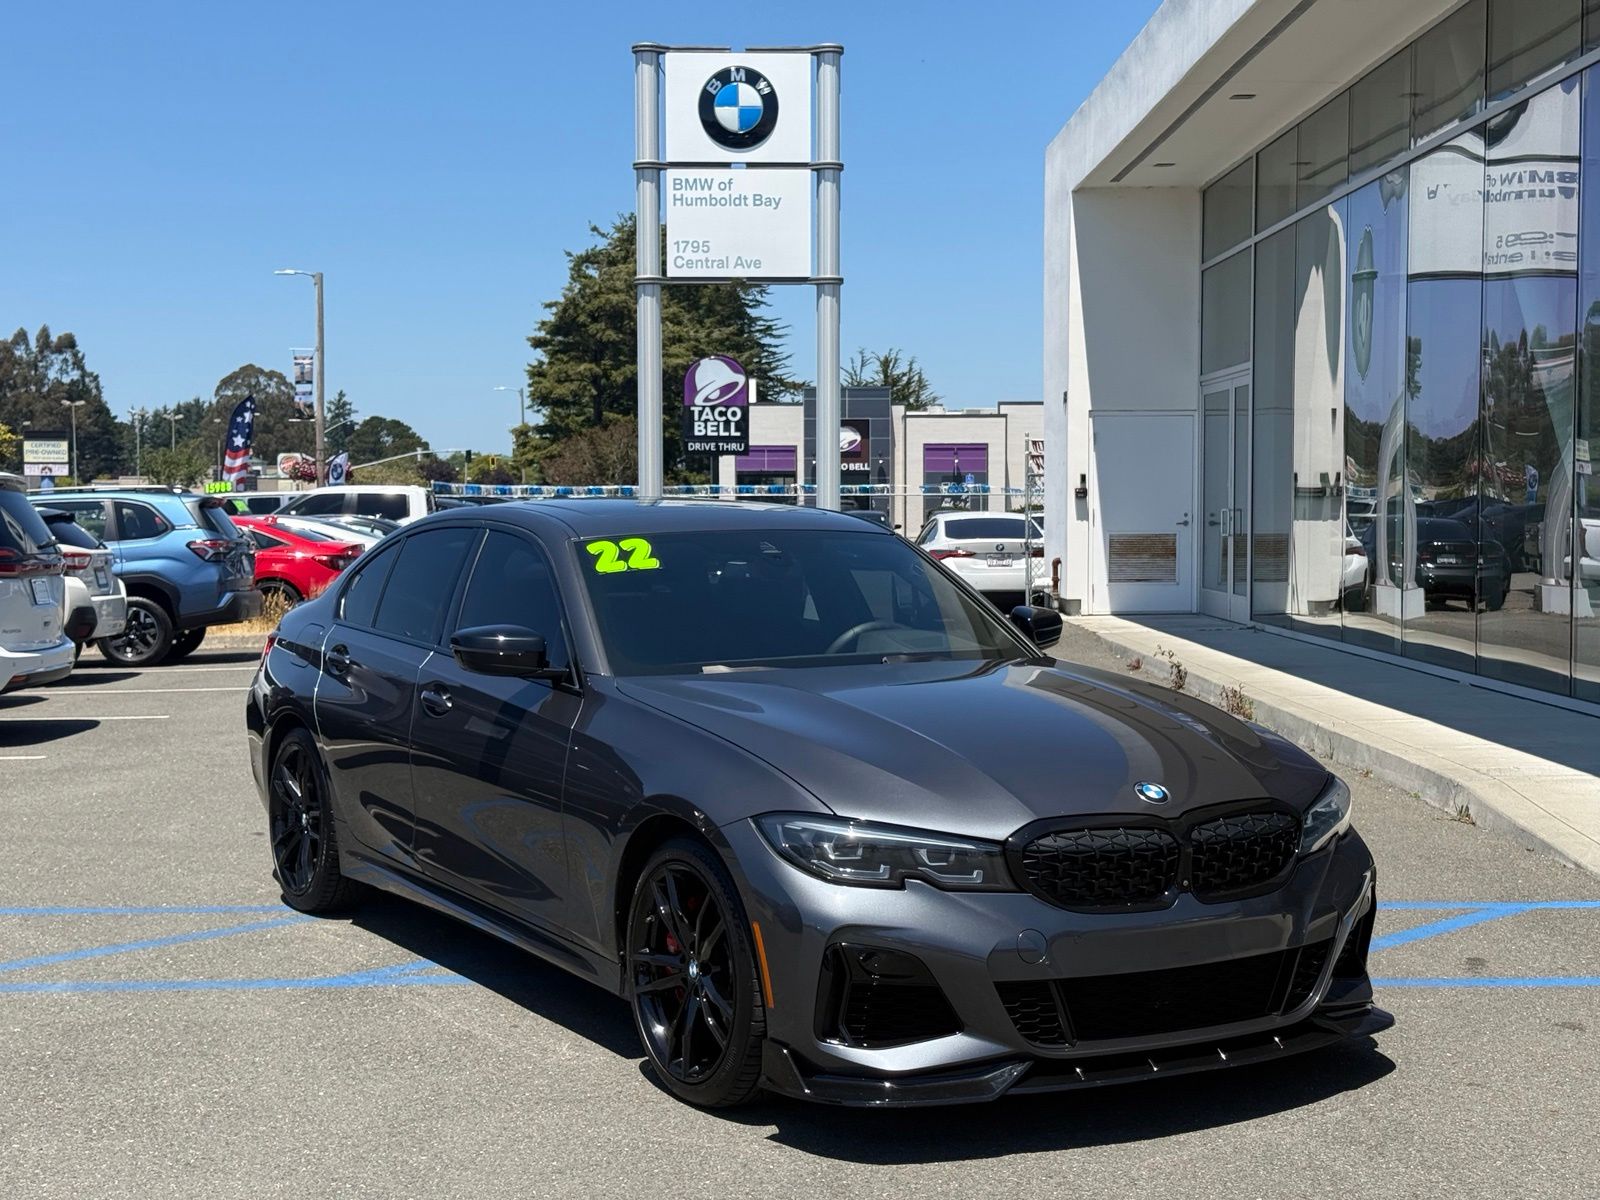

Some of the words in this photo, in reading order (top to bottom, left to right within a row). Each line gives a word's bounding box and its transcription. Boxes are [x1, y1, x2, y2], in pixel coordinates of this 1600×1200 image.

[706, 66, 772, 96] BMW
[672, 178, 714, 191] BMW
[717, 178, 734, 191] of
[672, 193, 749, 207] Humboldt
[752, 194, 782, 210] Bay
[673, 240, 711, 254] 1795
[673, 255, 729, 270] Central
[733, 256, 762, 270] Ave
[690, 406, 742, 422] TACO
[693, 421, 742, 437] BELL
[687, 442, 716, 452] DRIVE
[718, 442, 745, 452] THRU
[848, 462, 871, 471] BELL
[586, 538, 660, 573] 22
